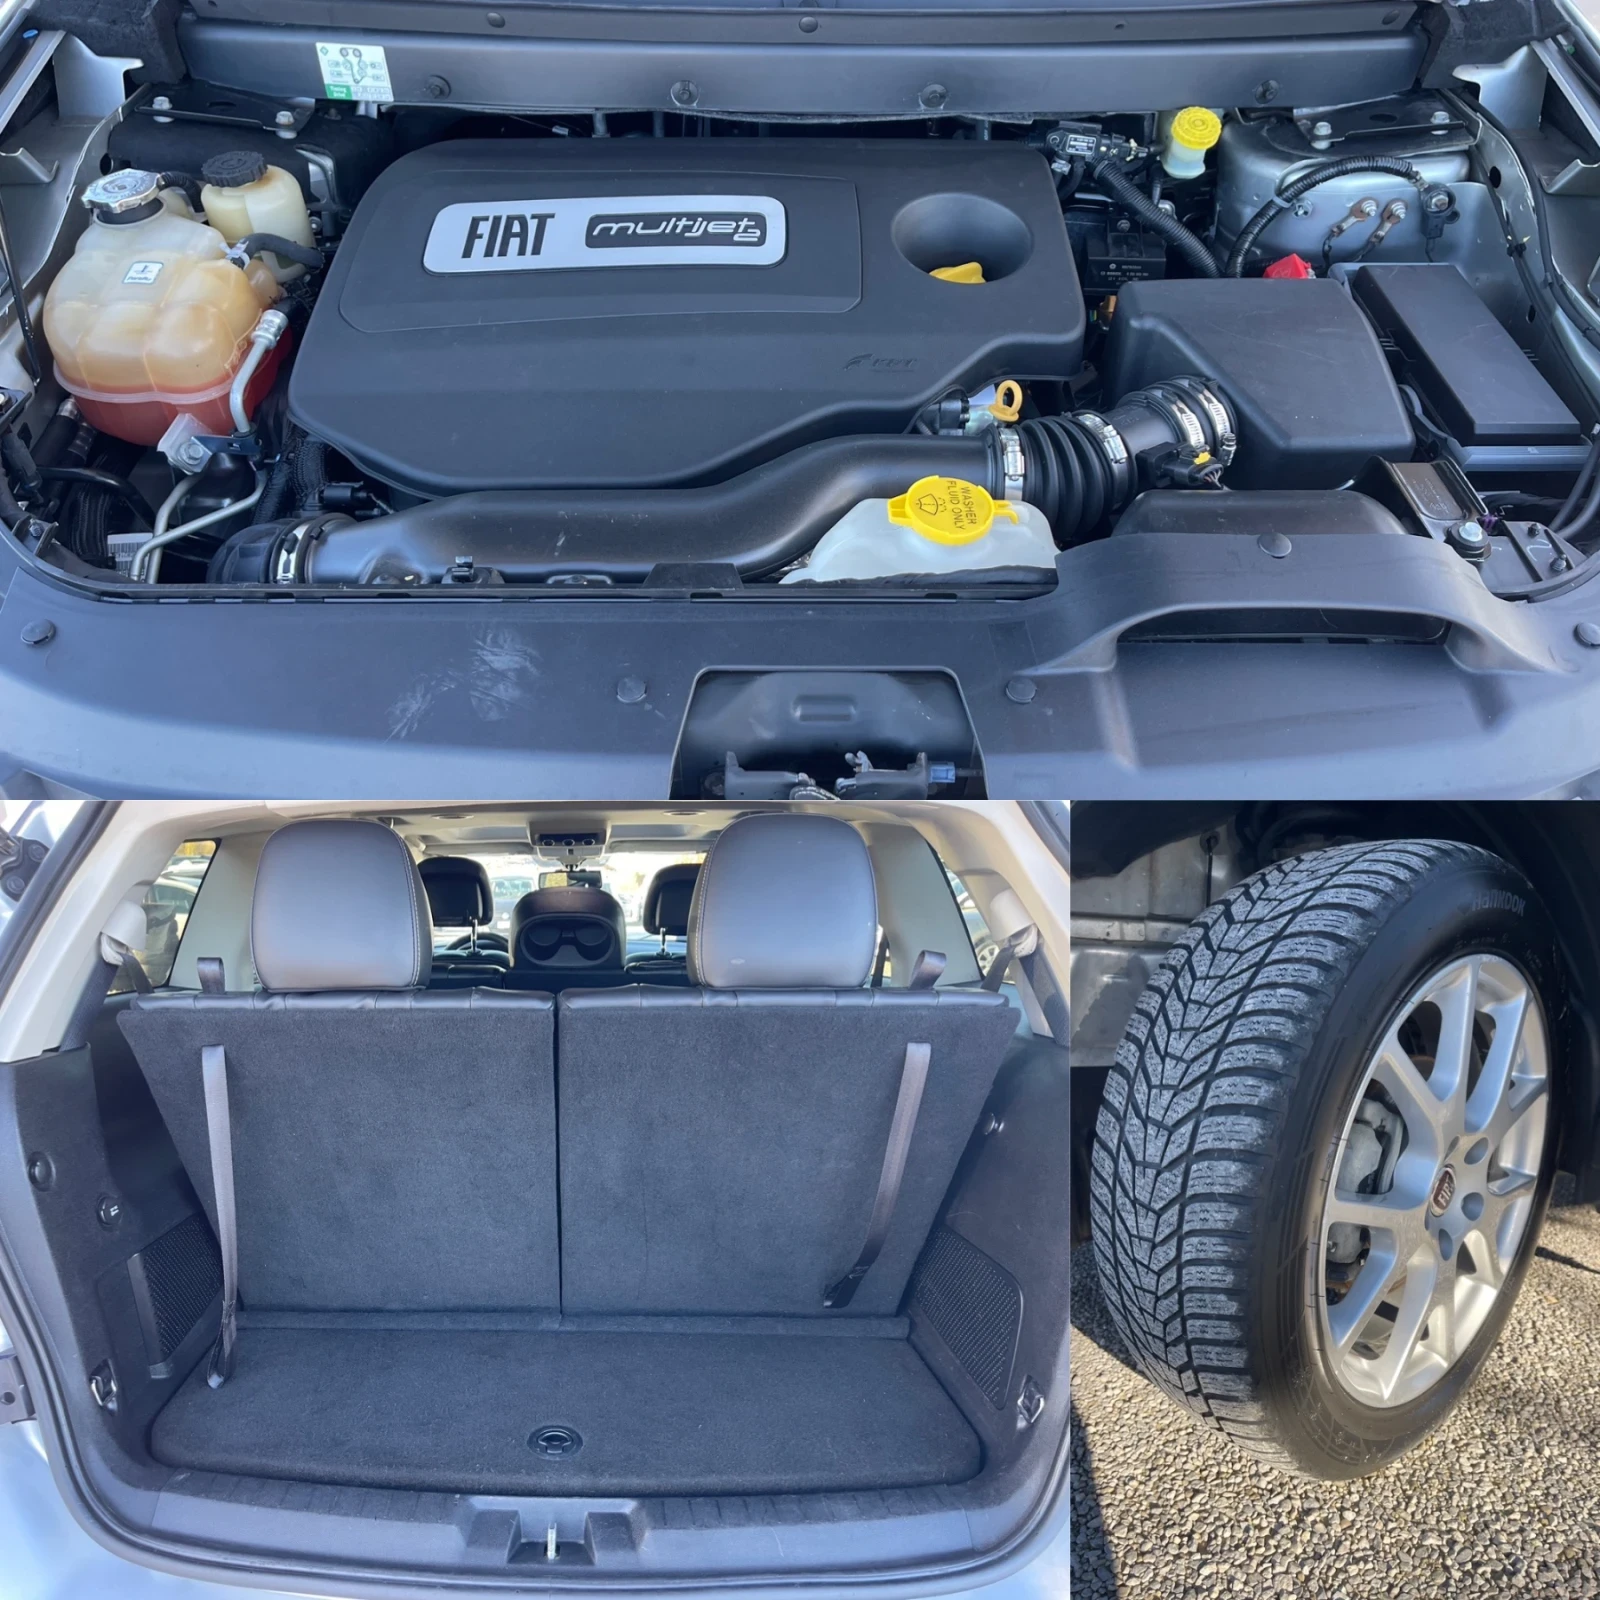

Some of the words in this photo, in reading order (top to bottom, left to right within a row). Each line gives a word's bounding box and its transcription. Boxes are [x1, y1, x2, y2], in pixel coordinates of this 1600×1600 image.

[461, 213, 556, 259] FIAT
[947, 480, 960, 505] FLUID
[960, 486, 977, 525] WASHER
[951, 507, 966, 530] ONLY
